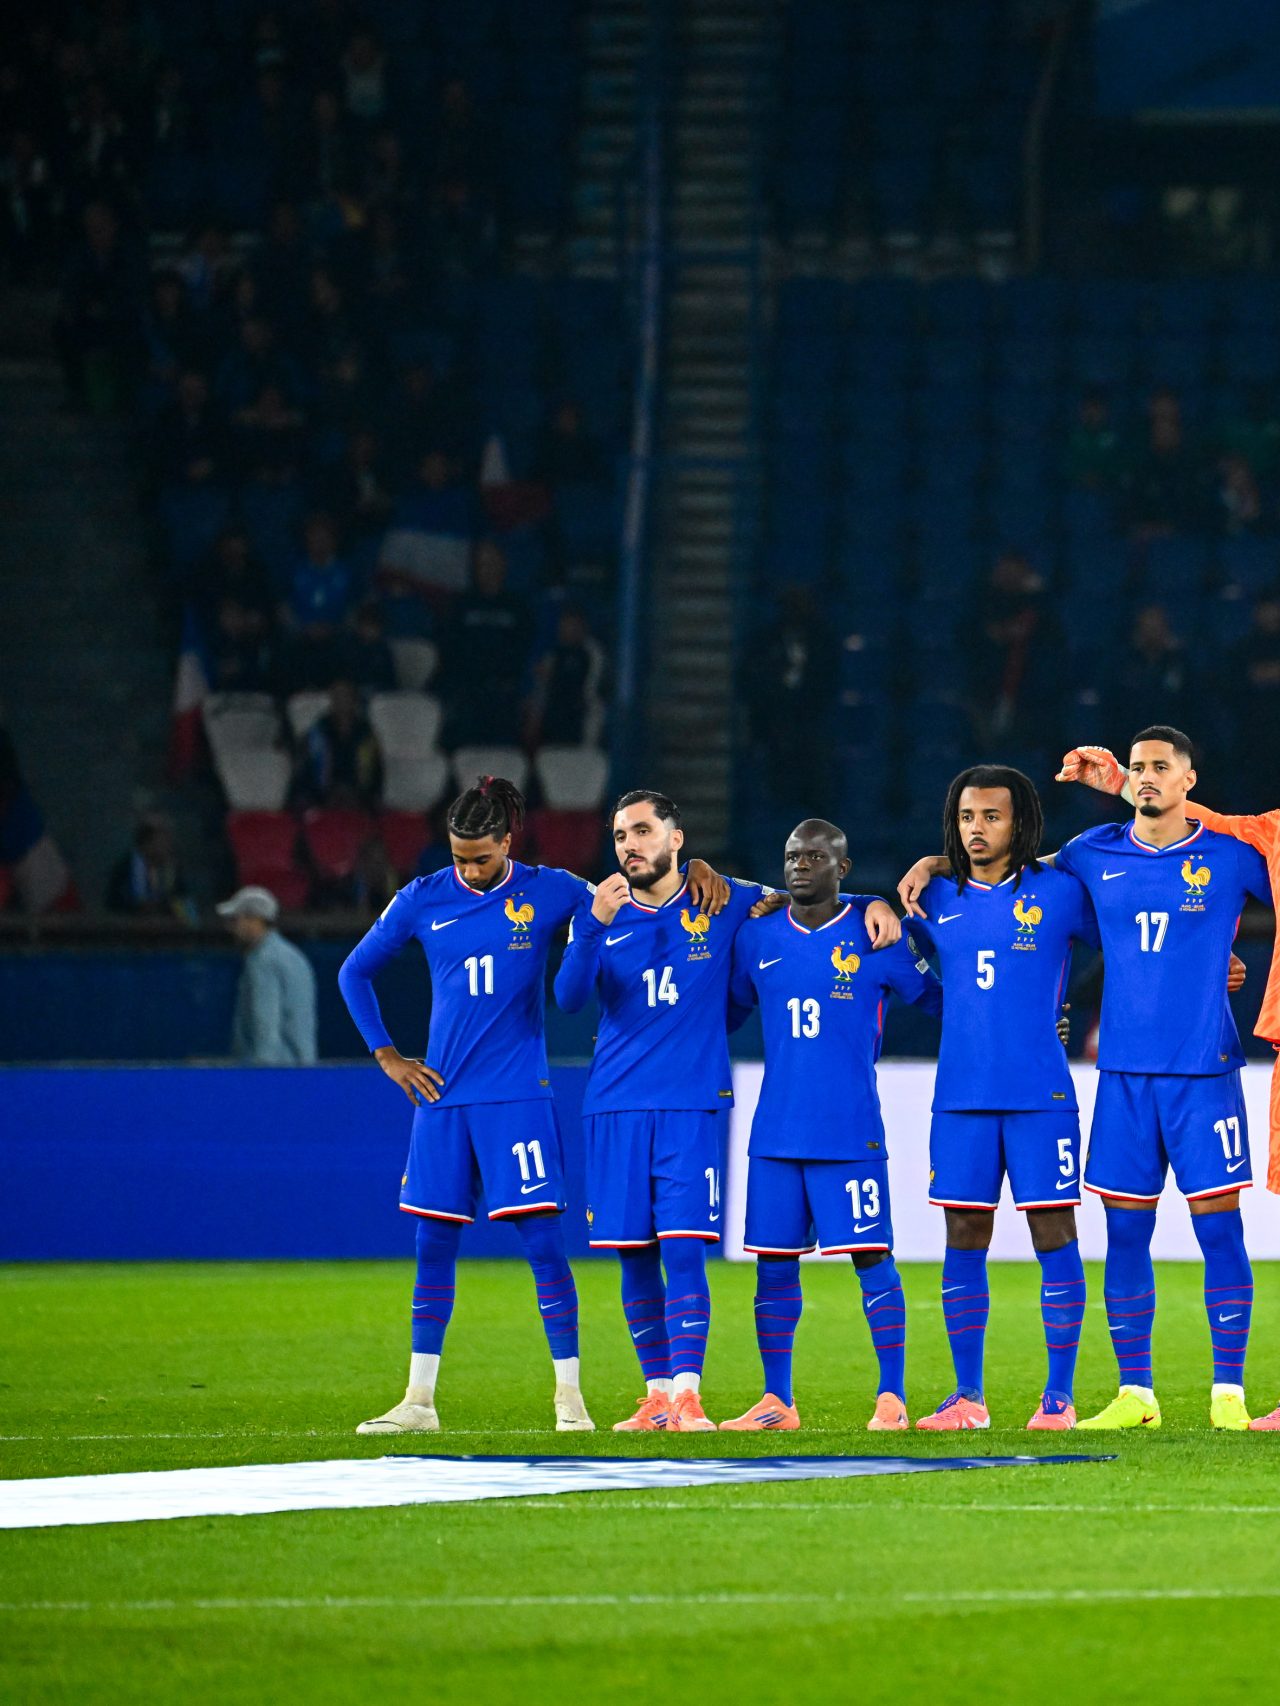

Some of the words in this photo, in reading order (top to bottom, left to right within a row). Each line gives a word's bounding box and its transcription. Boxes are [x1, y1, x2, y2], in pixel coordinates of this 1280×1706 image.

[1136, 912, 1169, 952] 17
[465, 955, 493, 995] 11
[643, 966, 678, 1007] 14
[977, 950, 995, 989] 5
[787, 998, 820, 1038] 13
[1057, 1138, 1074, 1176] 5
[1214, 1116, 1241, 1159] 17
[512, 1140, 545, 1180] 11
[705, 1168, 719, 1207] 1
[846, 1179, 880, 1219] 13
